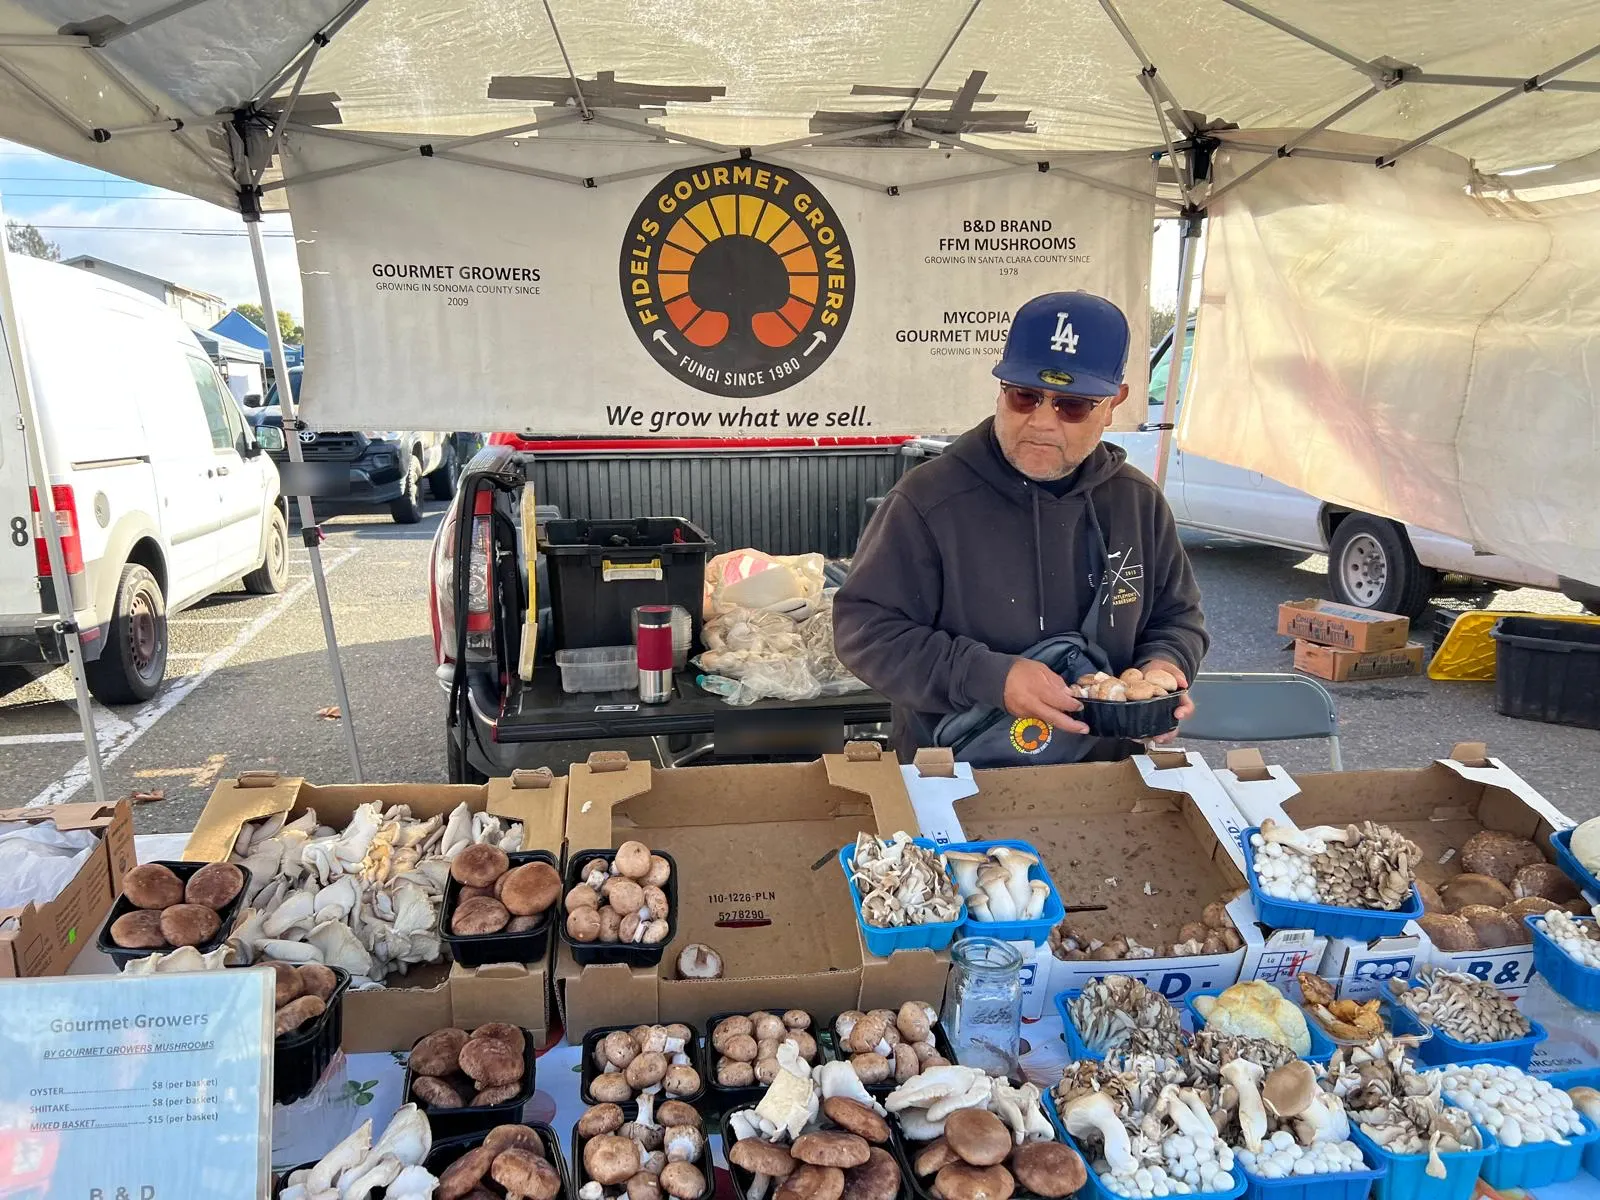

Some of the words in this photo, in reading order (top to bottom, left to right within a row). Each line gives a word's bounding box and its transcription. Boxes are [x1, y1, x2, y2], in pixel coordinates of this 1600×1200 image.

[963, 219, 996, 233] B&D
[1000, 219, 1052, 233] BRAND
[631, 217, 660, 325] FIDEL'S
[658, 166, 790, 213] GOURMET
[793, 193, 845, 327] GROWERS
[939, 238, 970, 251] FFM
[974, 237, 1076, 251] MUSHROOMS
[924, 255, 965, 264] GROWING
[968, 255, 976, 264] IN
[978, 256, 1004, 264] SANTA
[1005, 255, 1032, 264] CLARA
[1033, 255, 1067, 263] COUNTY
[1069, 255, 1091, 263] SINCE
[372, 263, 454, 279] GOURMET
[459, 266, 541, 282] GROWERS
[999, 267, 1019, 276] 1978
[376, 282, 419, 292] GROWING
[422, 283, 431, 292] IN
[433, 283, 474, 293] SONOMA
[476, 285, 512, 294] COUNTY
[515, 286, 540, 295] SINCE
[447, 297, 469, 306] 2009
[943, 311, 1011, 324] MYCOPIA
[895, 329, 971, 343] GOURMET
[930, 347, 971, 356] GROWING
[972, 347, 981, 355] IN
[679, 355, 720, 384] FUNGI
[724, 371, 765, 387] SINCE
[768, 357, 801, 381] 1980
[606, 405, 644, 427] We
[649, 411, 712, 433] grow
[718, 406, 780, 428] what
[786, 411, 819, 427] we
[825, 405, 872, 427] sell.
[10, 516, 29, 547] 8
[708, 891, 776, 904] 110-1226-PLN
[718, 909, 764, 921] 5278290
[50, 1015, 129, 1034] Gourmet
[134, 1013, 209, 1029] Growers
[43, 1050, 56, 1059] BY
[58, 1046, 103, 1057] GOURMET
[106, 1044, 152, 1055] GROWERS
[154, 1040, 215, 1052] MUSHROOMS
[152, 1081, 163, 1090] $8
[165, 1079, 183, 1090] (per
[185, 1078, 218, 1088] basket)
[152, 1098, 163, 1107] $8
[165, 1097, 183, 1107] (per
[185, 1095, 218, 1105] basket)
[30, 1121, 60, 1131] MIXED
[148, 1115, 164, 1124] $15
[166, 1114, 184, 1125] (per
[186, 1112, 219, 1122] basket)
